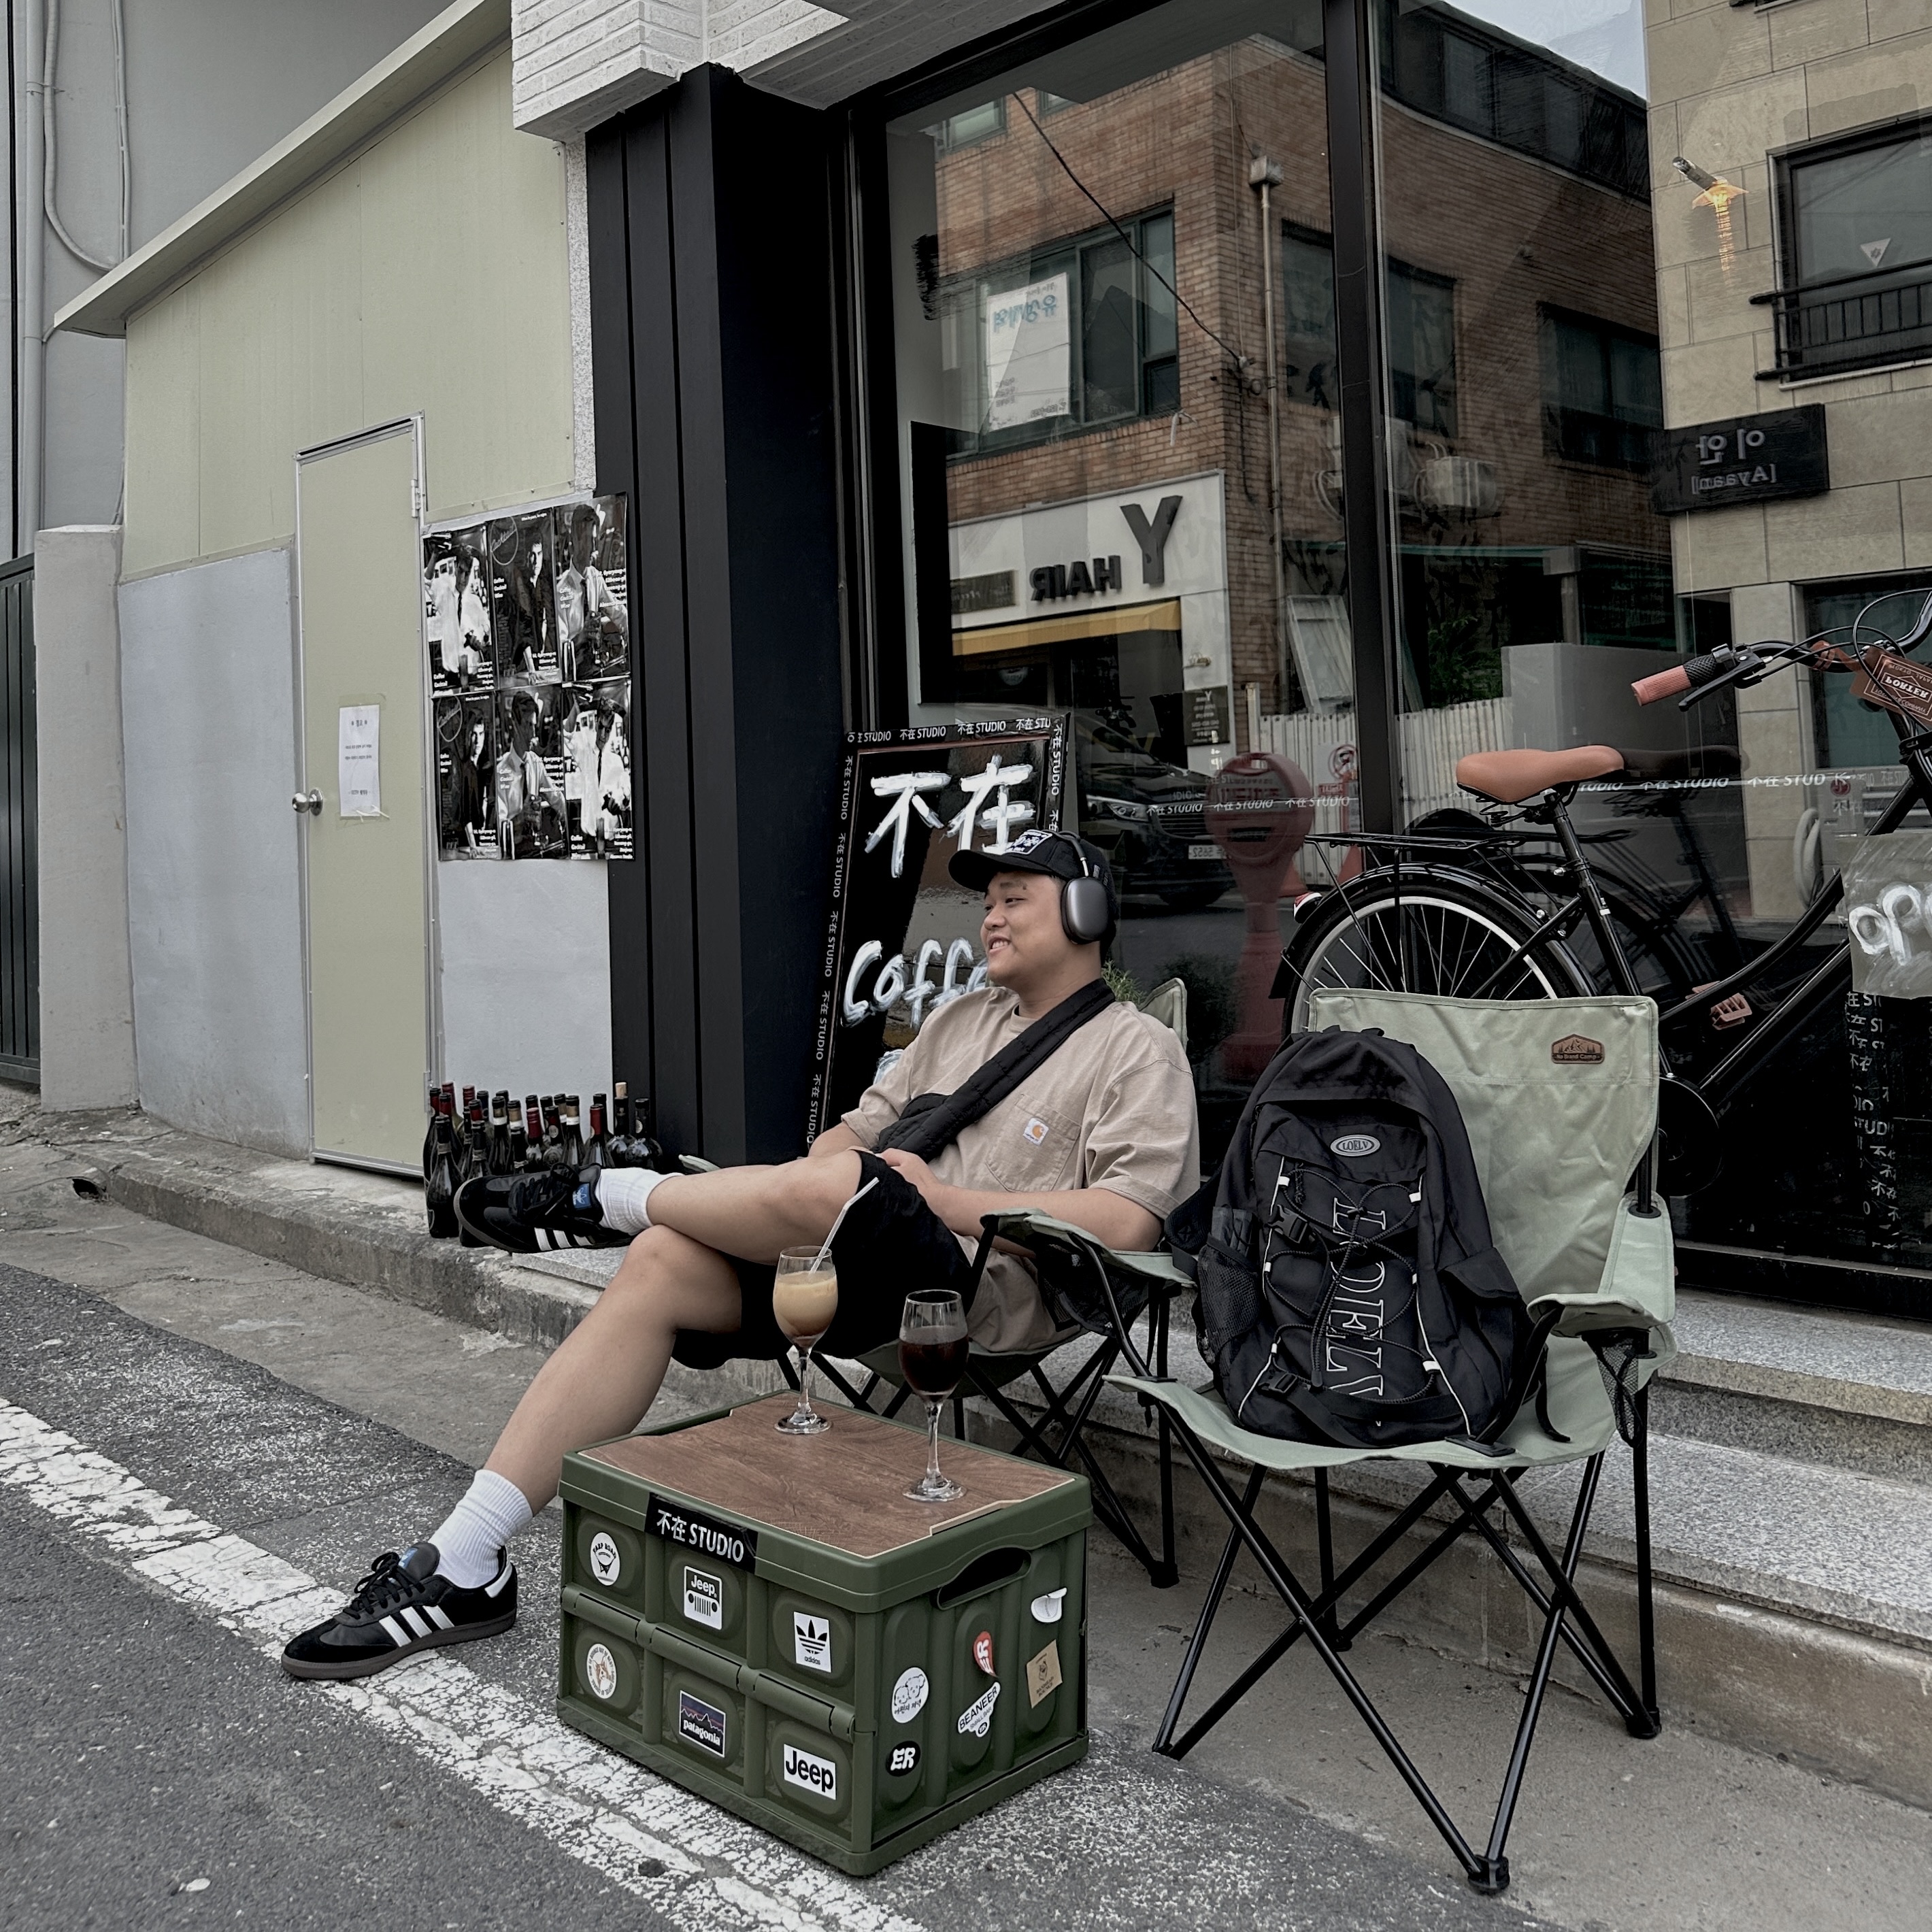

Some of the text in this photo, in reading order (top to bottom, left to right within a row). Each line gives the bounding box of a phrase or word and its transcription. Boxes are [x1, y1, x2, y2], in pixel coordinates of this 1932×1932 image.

[863, 731, 892, 742] STUDIO
[899, 726, 947, 741] 不在 STUDIO
[957, 721, 1006, 735] 不在 STUDIO
[1016, 718, 1033, 731] 不在
[1051, 723, 1063, 796] 不在 STUDIO
[841, 755, 853, 820] 不在 STUDIO
[1672, 777, 1729, 789] STUDIO
[1167, 803, 1203, 815] STUDIO
[1235, 799, 1274, 811] STUDIO
[1309, 795, 1350, 808] STUDIO
[865, 754, 1037, 878] 不在
[833, 832, 846, 898] 不在 STUDIO
[825, 910, 838, 978] 不在 STUDIO
[816, 990, 830, 1061] 不在 STUDIO
[807, 1073, 822, 1144] 不在 STUDIO
[1342, 1139, 1369, 1151] LOELV
[656, 1509, 744, 1563] 不在 STUDIO
[804, 1656, 821, 1665] adidas
[959, 1686, 998, 1731] BEANEER
[683, 1718, 721, 1747] patagonia
[785, 1750, 834, 1793] Jeep
[890, 1747, 916, 1771] ER
